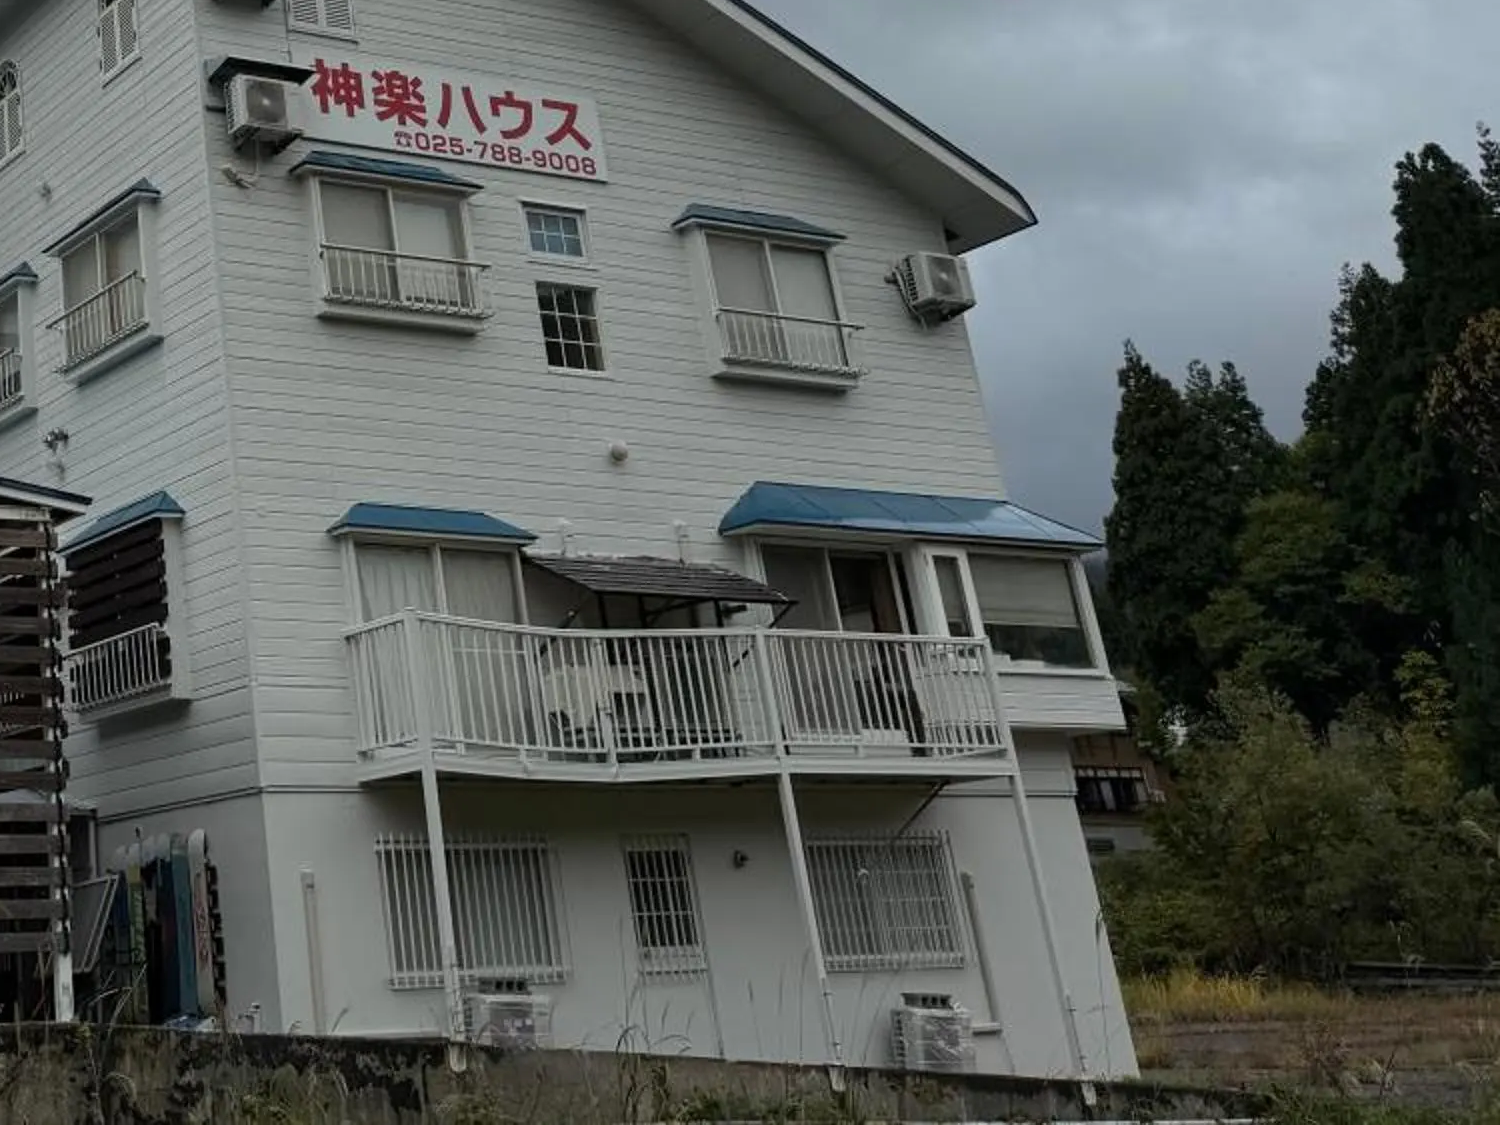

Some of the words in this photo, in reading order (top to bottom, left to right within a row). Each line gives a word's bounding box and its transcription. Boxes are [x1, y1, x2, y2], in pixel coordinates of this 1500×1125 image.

[310, 58, 592, 151] 神楽ハウス
